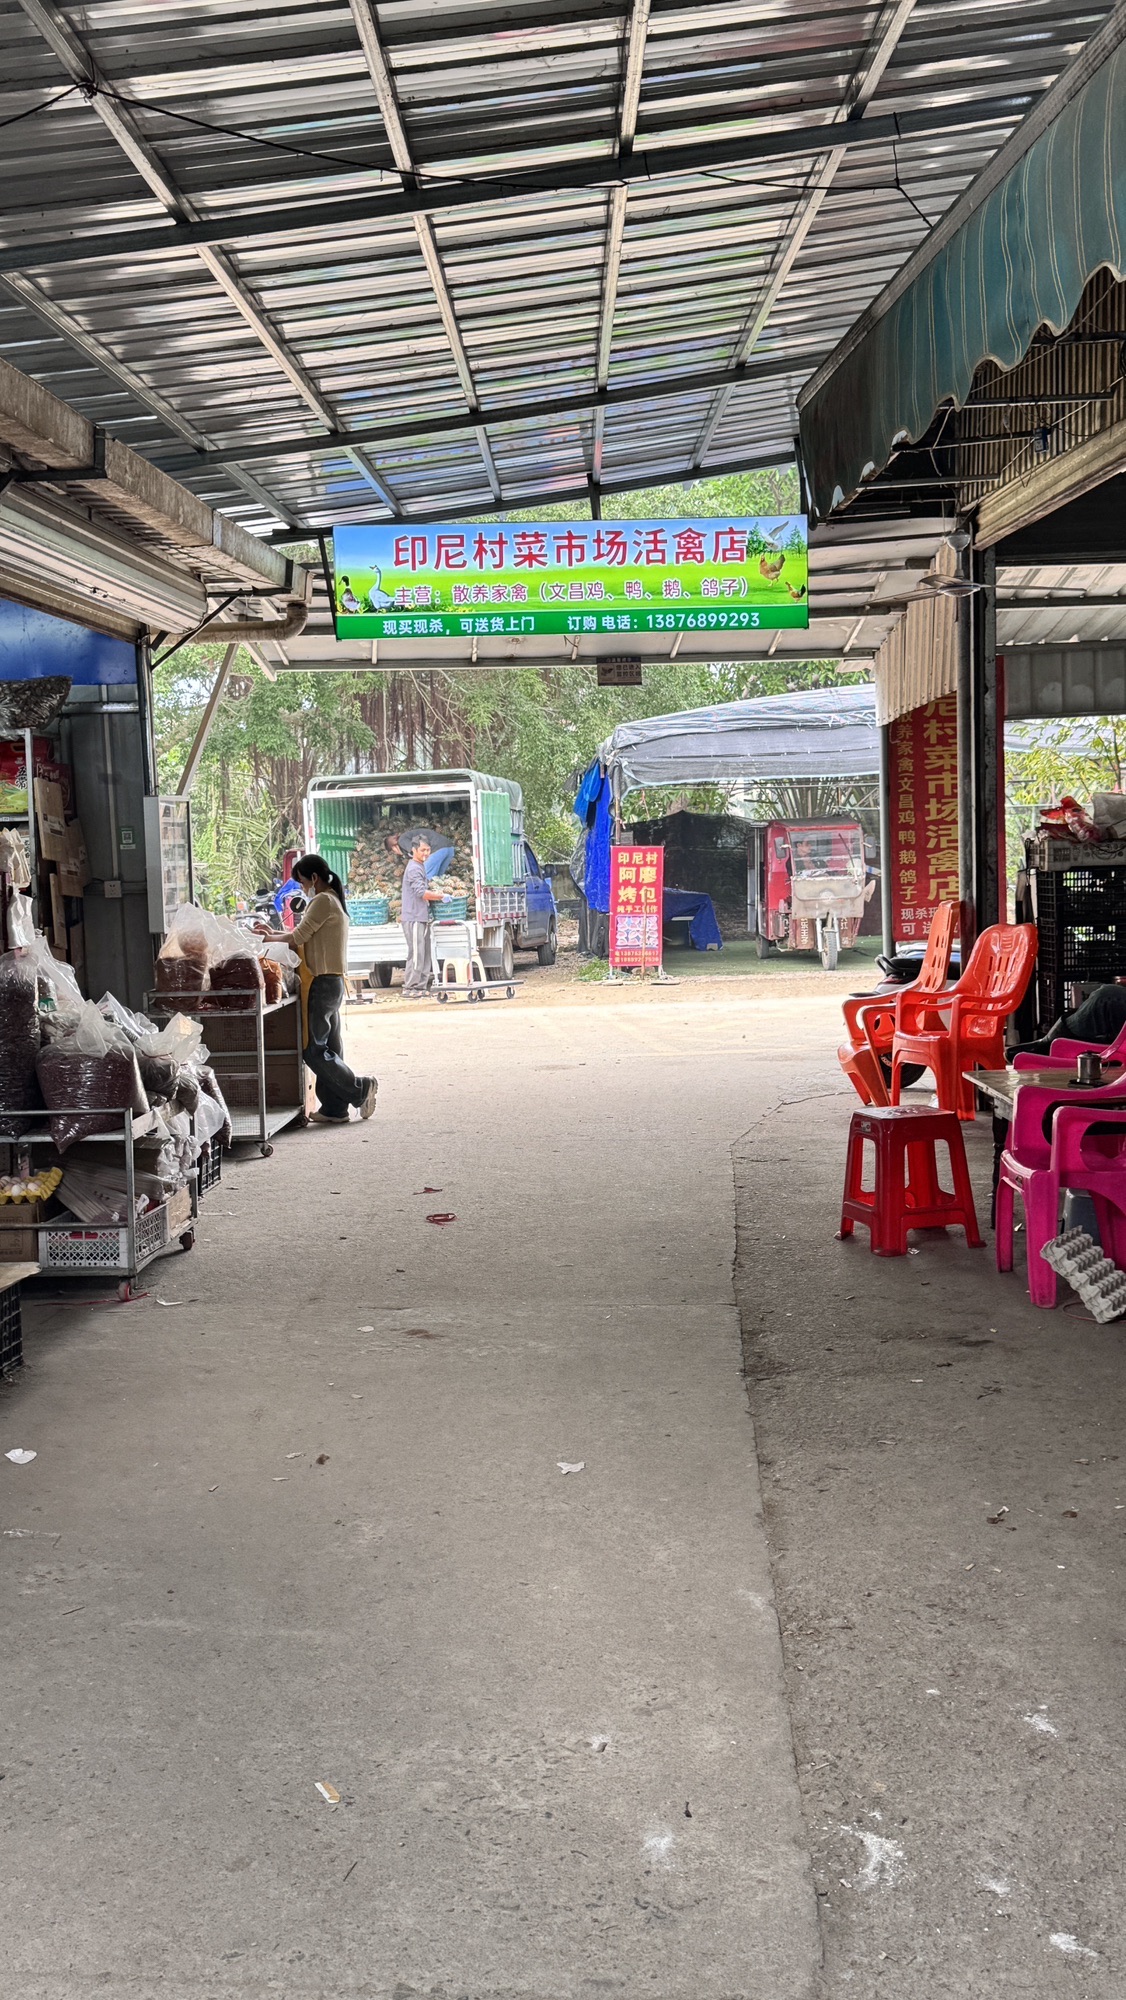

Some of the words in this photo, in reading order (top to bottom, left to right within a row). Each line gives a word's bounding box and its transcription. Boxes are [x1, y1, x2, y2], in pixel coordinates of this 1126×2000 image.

[393, 527, 748, 571] 印尼村菜市场活禽店
[617, 851, 658, 865] 印尼村
[618, 866, 657, 884] 阿廖
[617, 885, 657, 903] 烤包
